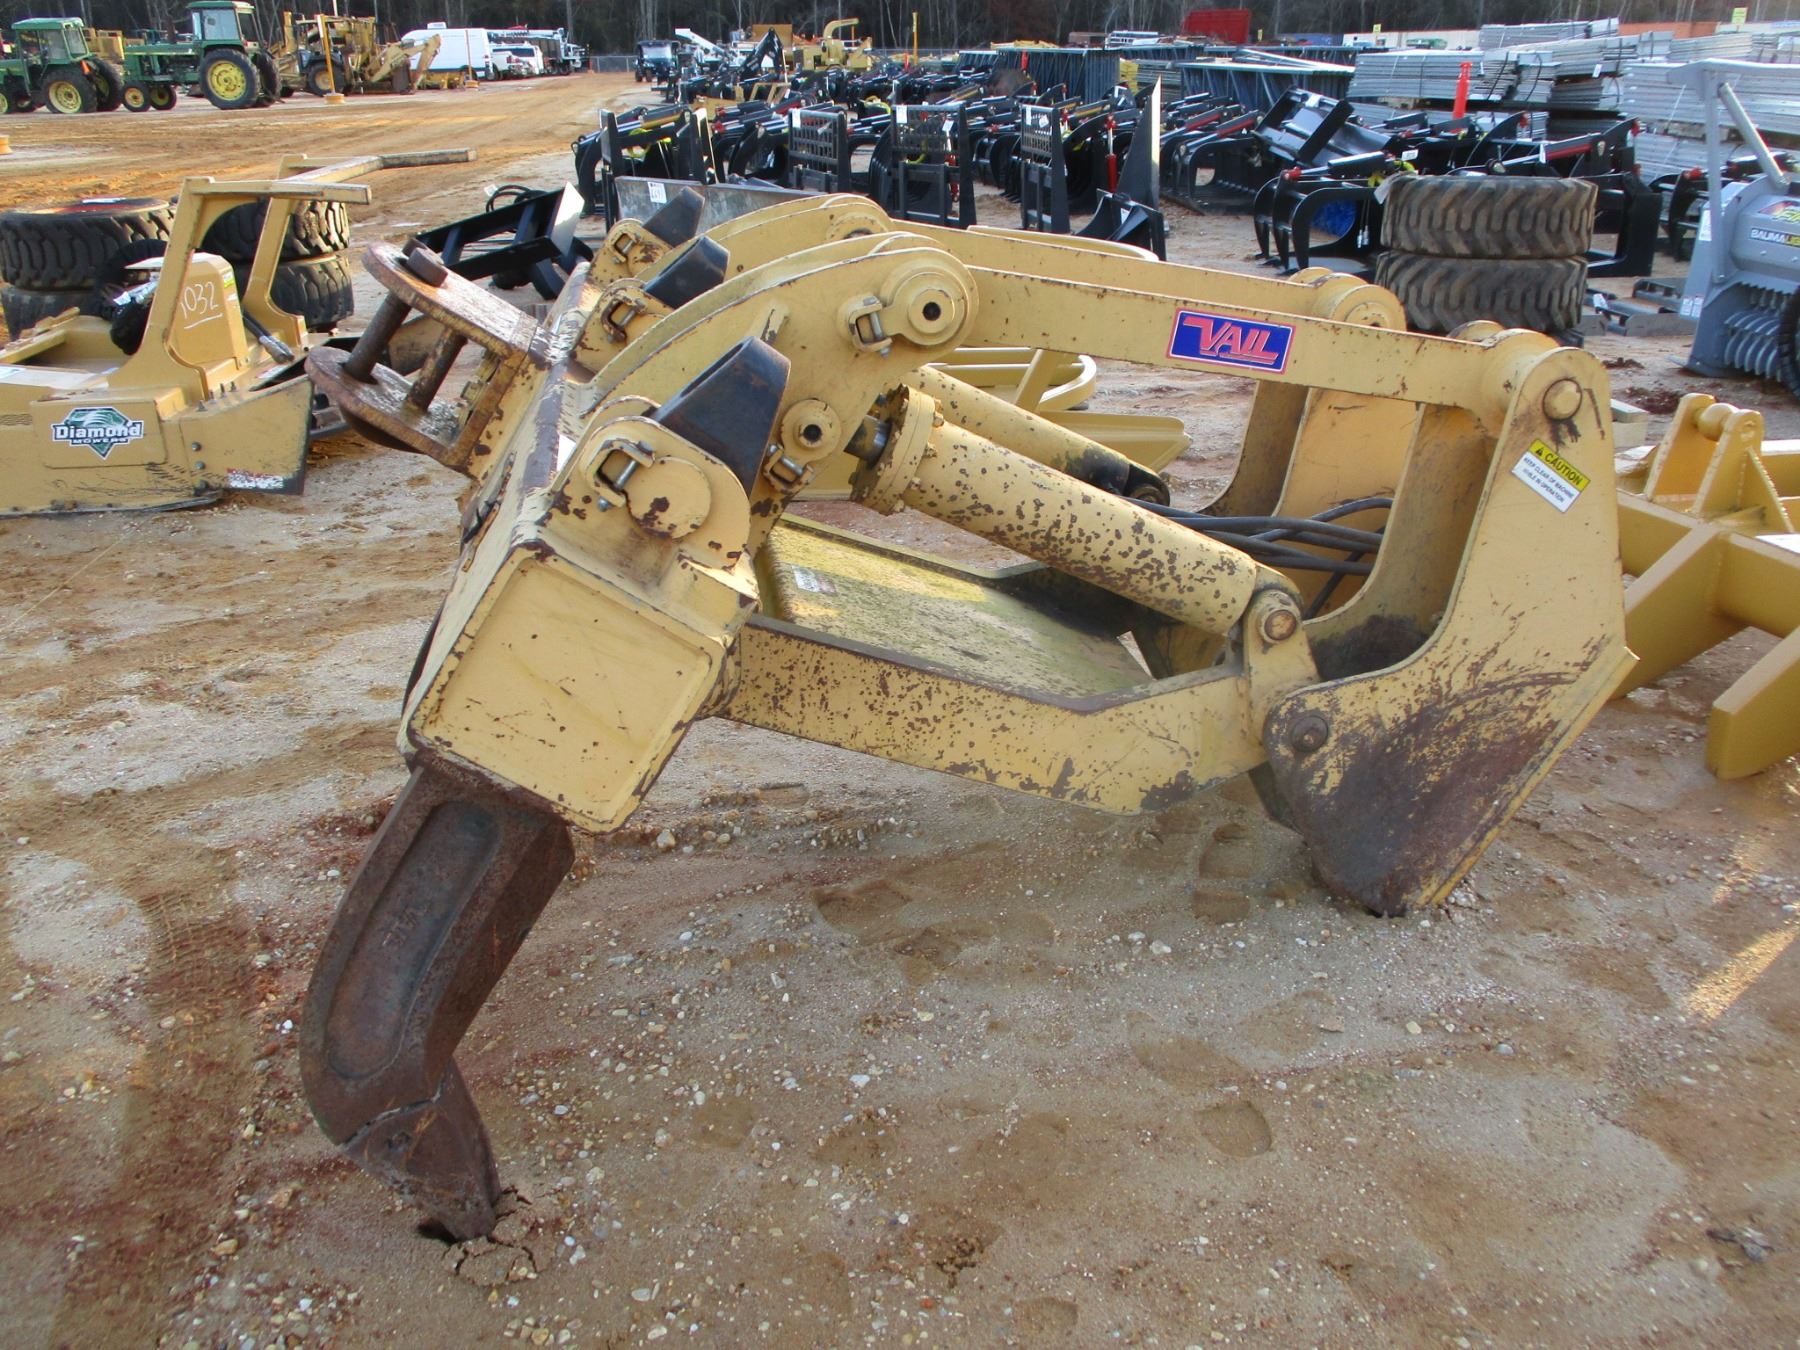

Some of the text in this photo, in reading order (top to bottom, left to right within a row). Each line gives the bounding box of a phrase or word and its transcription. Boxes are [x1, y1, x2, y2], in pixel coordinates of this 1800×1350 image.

[180, 281, 219, 319] 1032
[1183, 316, 1279, 362] VAIL
[56, 421, 141, 439] Diamond
[1544, 453, 1583, 486] CAUTION
